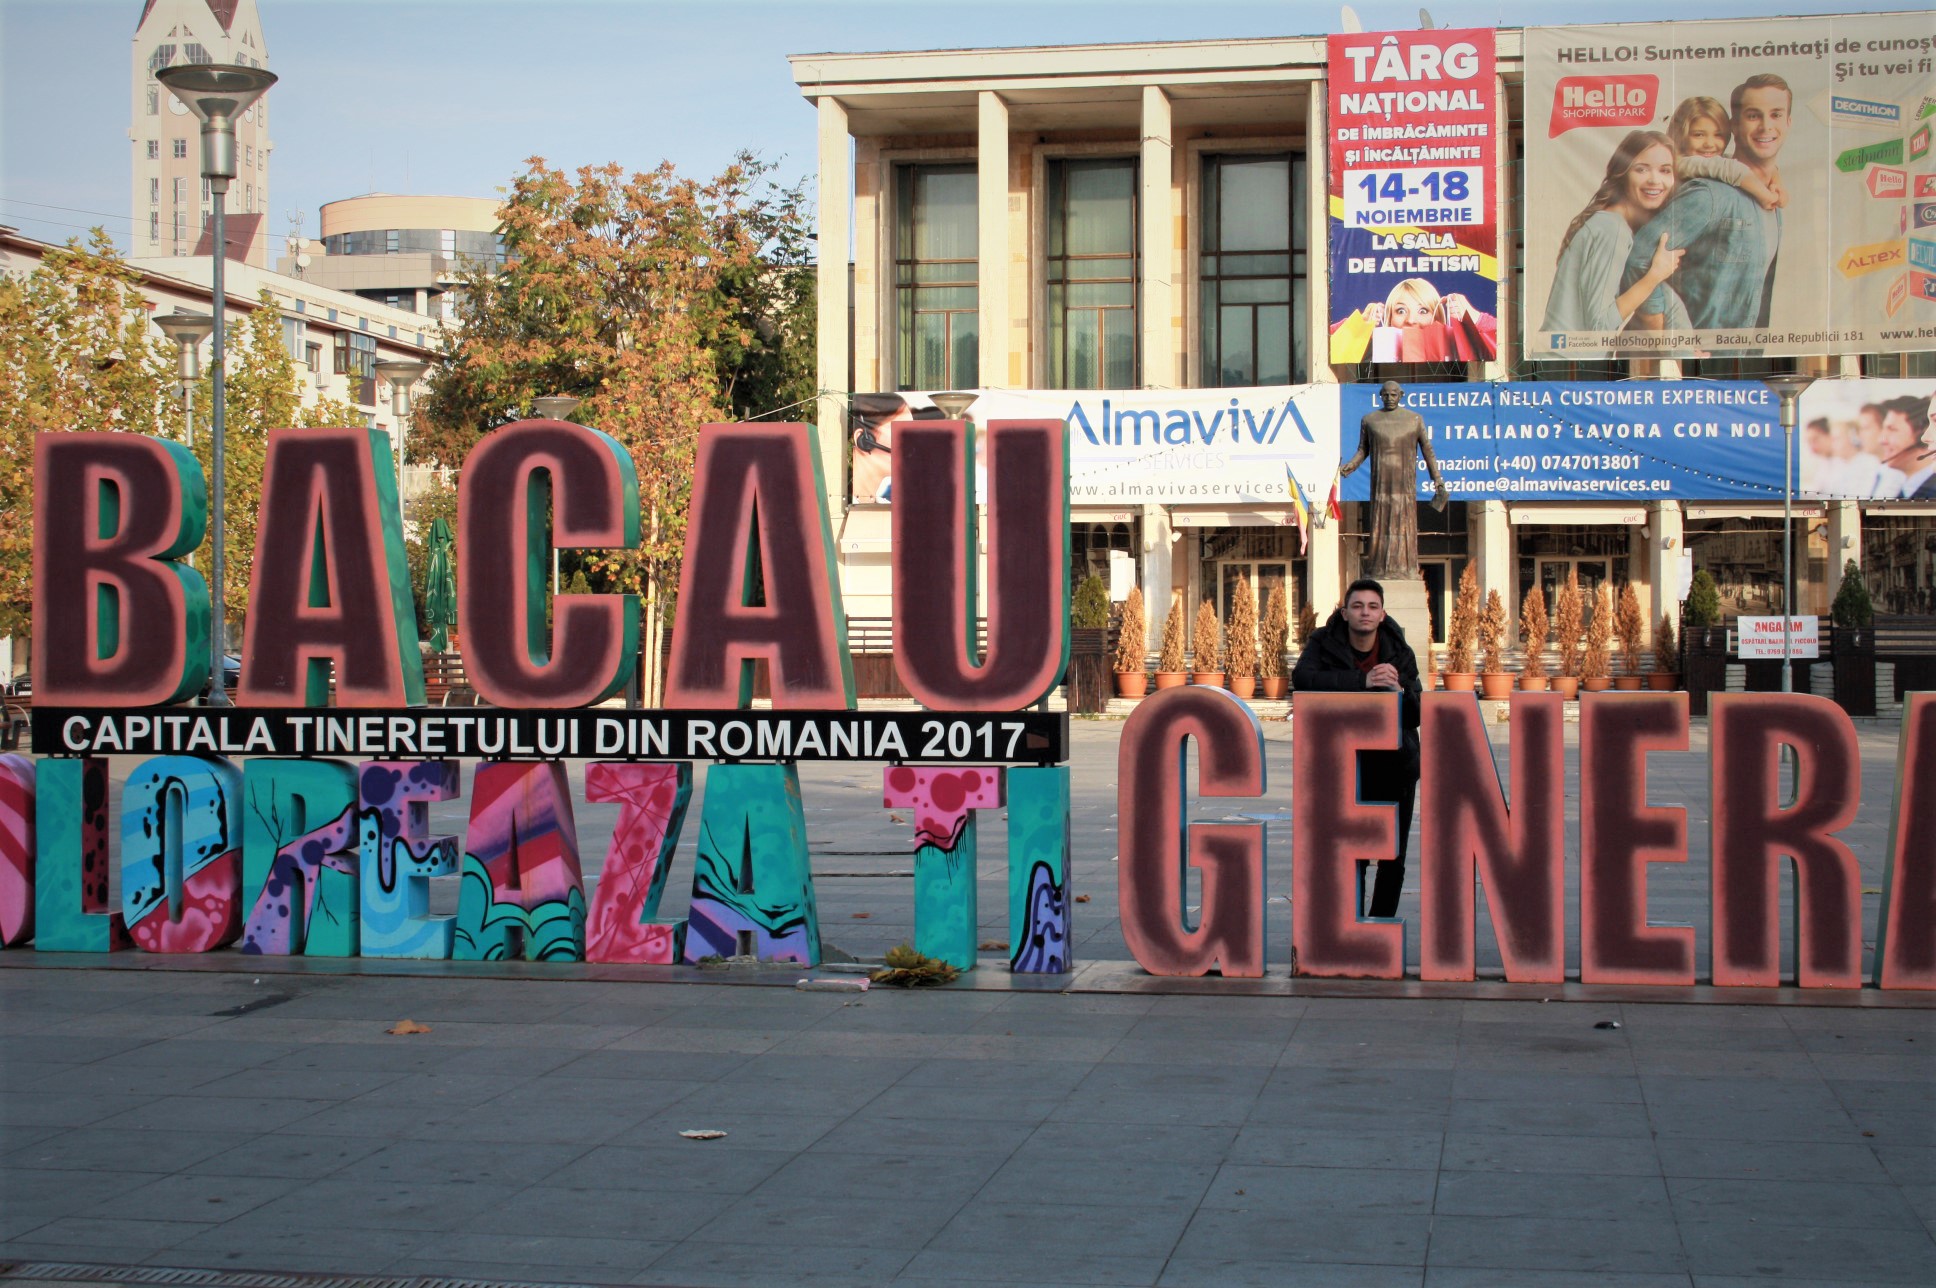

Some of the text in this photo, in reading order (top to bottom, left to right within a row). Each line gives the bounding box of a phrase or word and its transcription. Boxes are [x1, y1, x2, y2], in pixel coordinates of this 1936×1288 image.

[1344, 35, 1479, 83] TÂRG
[1557, 46, 1638, 63] HELLO!
[1644, 45, 1726, 62] Suntem
[1834, 38, 1861, 54] de
[1858, 62, 1879, 76] tu
[1883, 59, 1913, 74] vei
[1918, 57, 1932, 73] fi
[1563, 83, 1647, 108] Hello
[1562, 107, 1646, 119] SHOPPING PARK
[1834, 100, 1897, 117] DECATHLON
[1337, 123, 1488, 141] DE ÎMBRĂCĂMINTE
[1842, 146, 1900, 168] steilmann
[1358, 170, 1470, 204] 14-18
[1880, 174, 1902, 184] Hello
[1356, 207, 1472, 225] NOIEMBRIE
[1372, 232, 1458, 251] LA SALA
[1348, 254, 1480, 274] DE ATLETISM
[1601, 335, 1702, 348] HelloShoppingPark
[1755, 333, 1784, 344] Calea
[1788, 331, 1840, 345] Republicii
[1844, 331, 1865, 341] 181
[1499, 391, 1553, 407] NELLA
[1560, 390, 1654, 406] CUSTOMER
[1661, 389, 1769, 405] EXPERIENCE
[1445, 424, 1562, 440] ITALIANO?
[1574, 423, 1661, 439] LAVORA
[1673, 423, 1718, 438] CON
[1731, 423, 1770, 438] NOI
[1144, 449, 1224, 470] SERVICES
[1494, 455, 1537, 473] (+40)
[1541, 455, 1640, 470] 0747013801
[1421, 476, 1671, 492] seezione@almavivaservices.eu
[32, 418, 1071, 712] BACAU
[62, 715, 1026, 759] CAPITALA TINERETULUI DIN ROMANIA 2017
